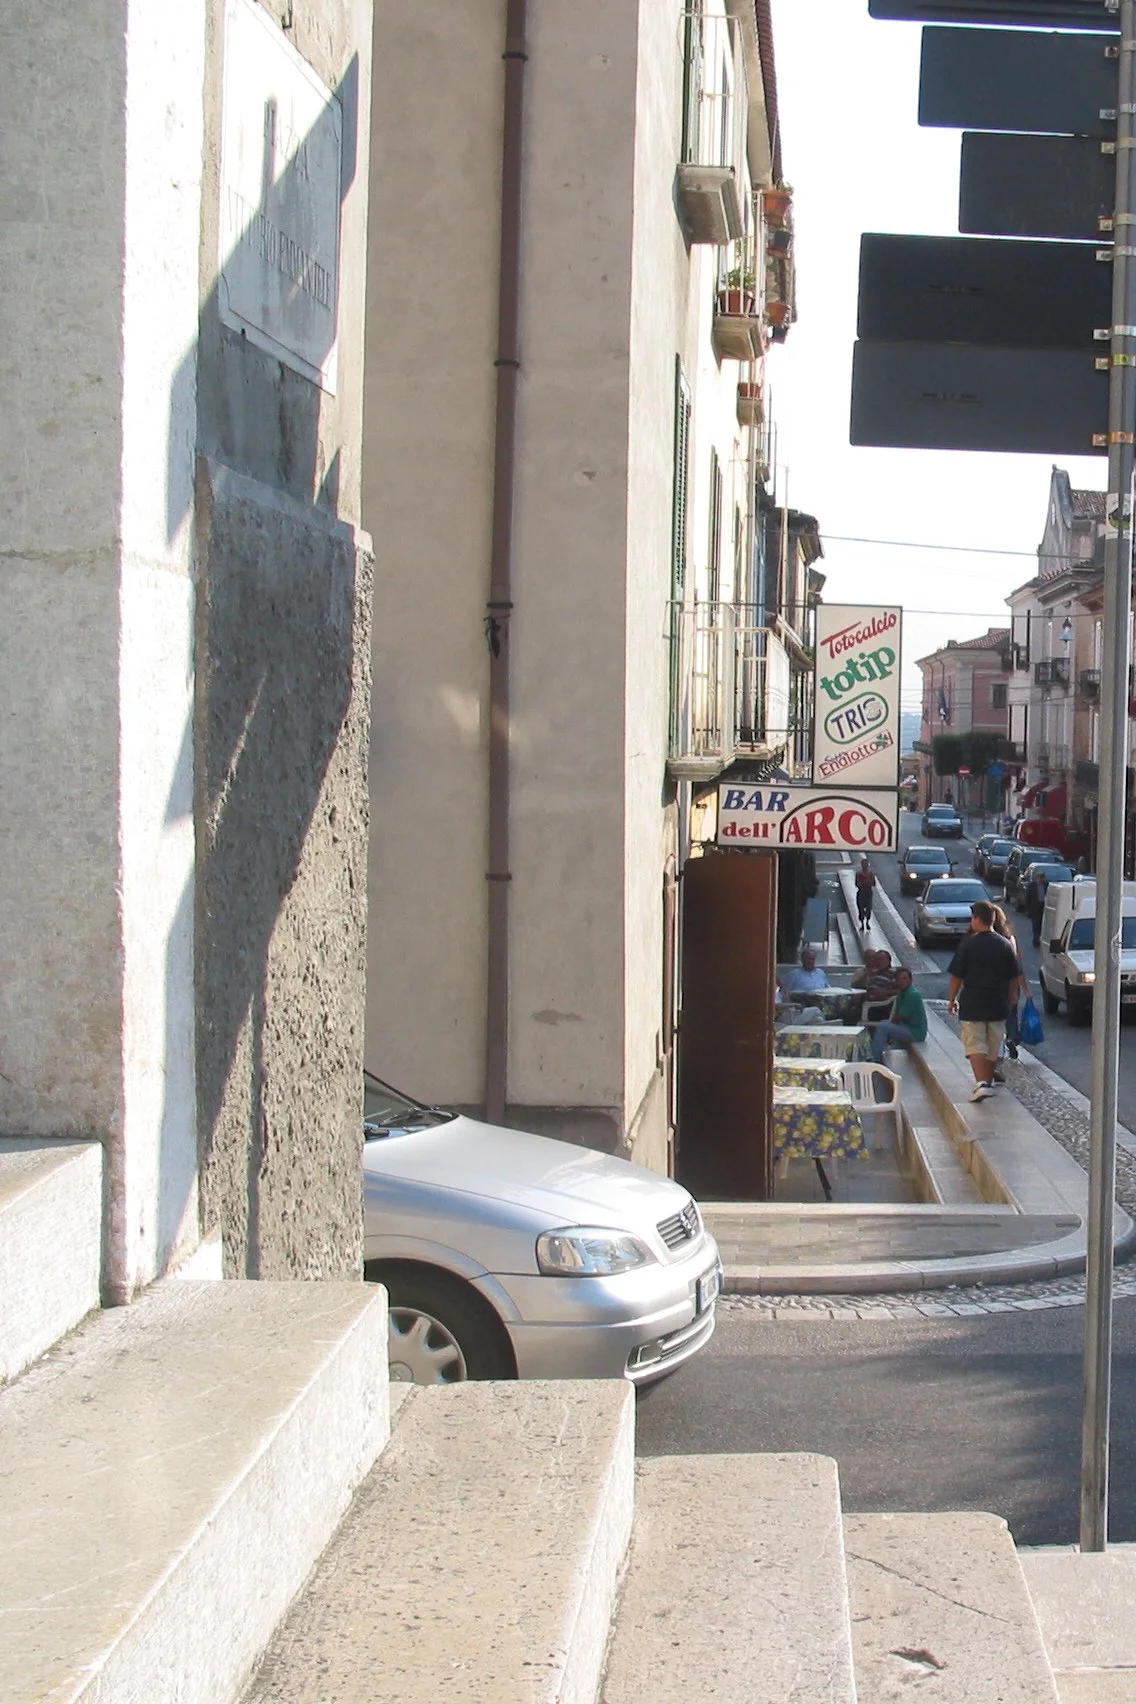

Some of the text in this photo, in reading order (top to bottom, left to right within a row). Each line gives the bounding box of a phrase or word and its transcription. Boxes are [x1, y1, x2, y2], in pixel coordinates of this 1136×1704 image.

[820, 611, 897, 659] Totocalcio
[820, 647, 896, 700] totip
[819, 741, 880, 776] Enalotto
[722, 789, 789, 812] BAR
[722, 806, 886, 846] dell' ARCO
